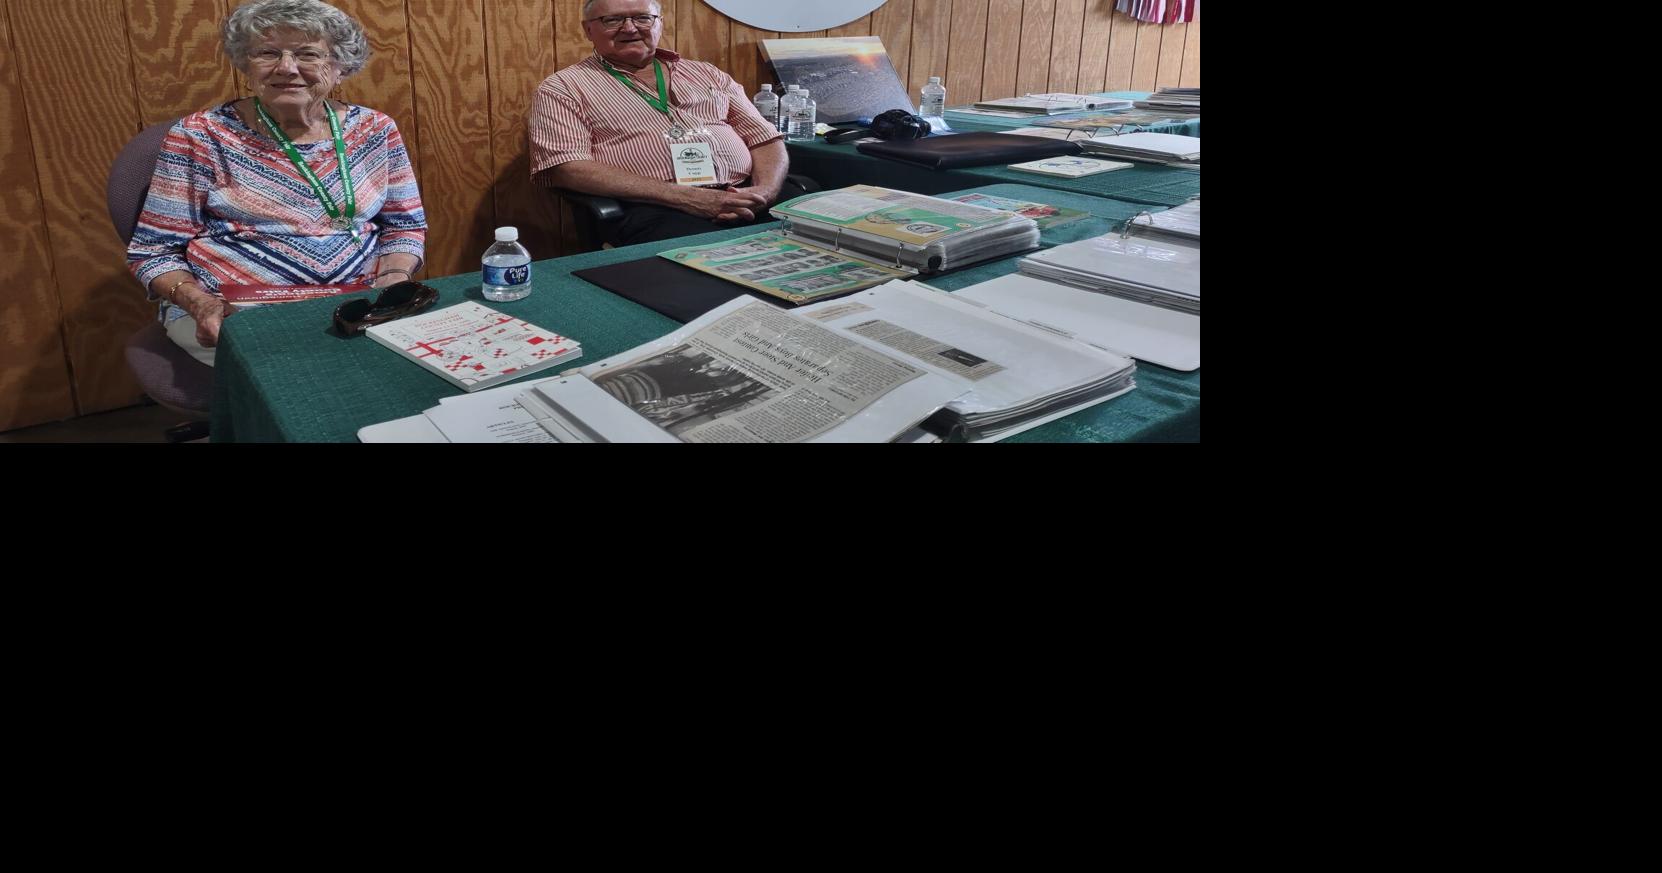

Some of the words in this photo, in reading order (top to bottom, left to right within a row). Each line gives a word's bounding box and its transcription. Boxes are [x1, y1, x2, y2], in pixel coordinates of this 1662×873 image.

[317, 186, 329, 202] County
[344, 179, 352, 198] County
[509, 266, 527, 274] Pure
[744, 331, 760, 341] Girls
[733, 338, 759, 353] Contest
[758, 338, 773, 349] And
[759, 350, 777, 362] Steer
[775, 346, 794, 359] Boys
[777, 359, 793, 370] And
[793, 355, 831, 376] Separates
[796, 368, 822, 383] Heifer
